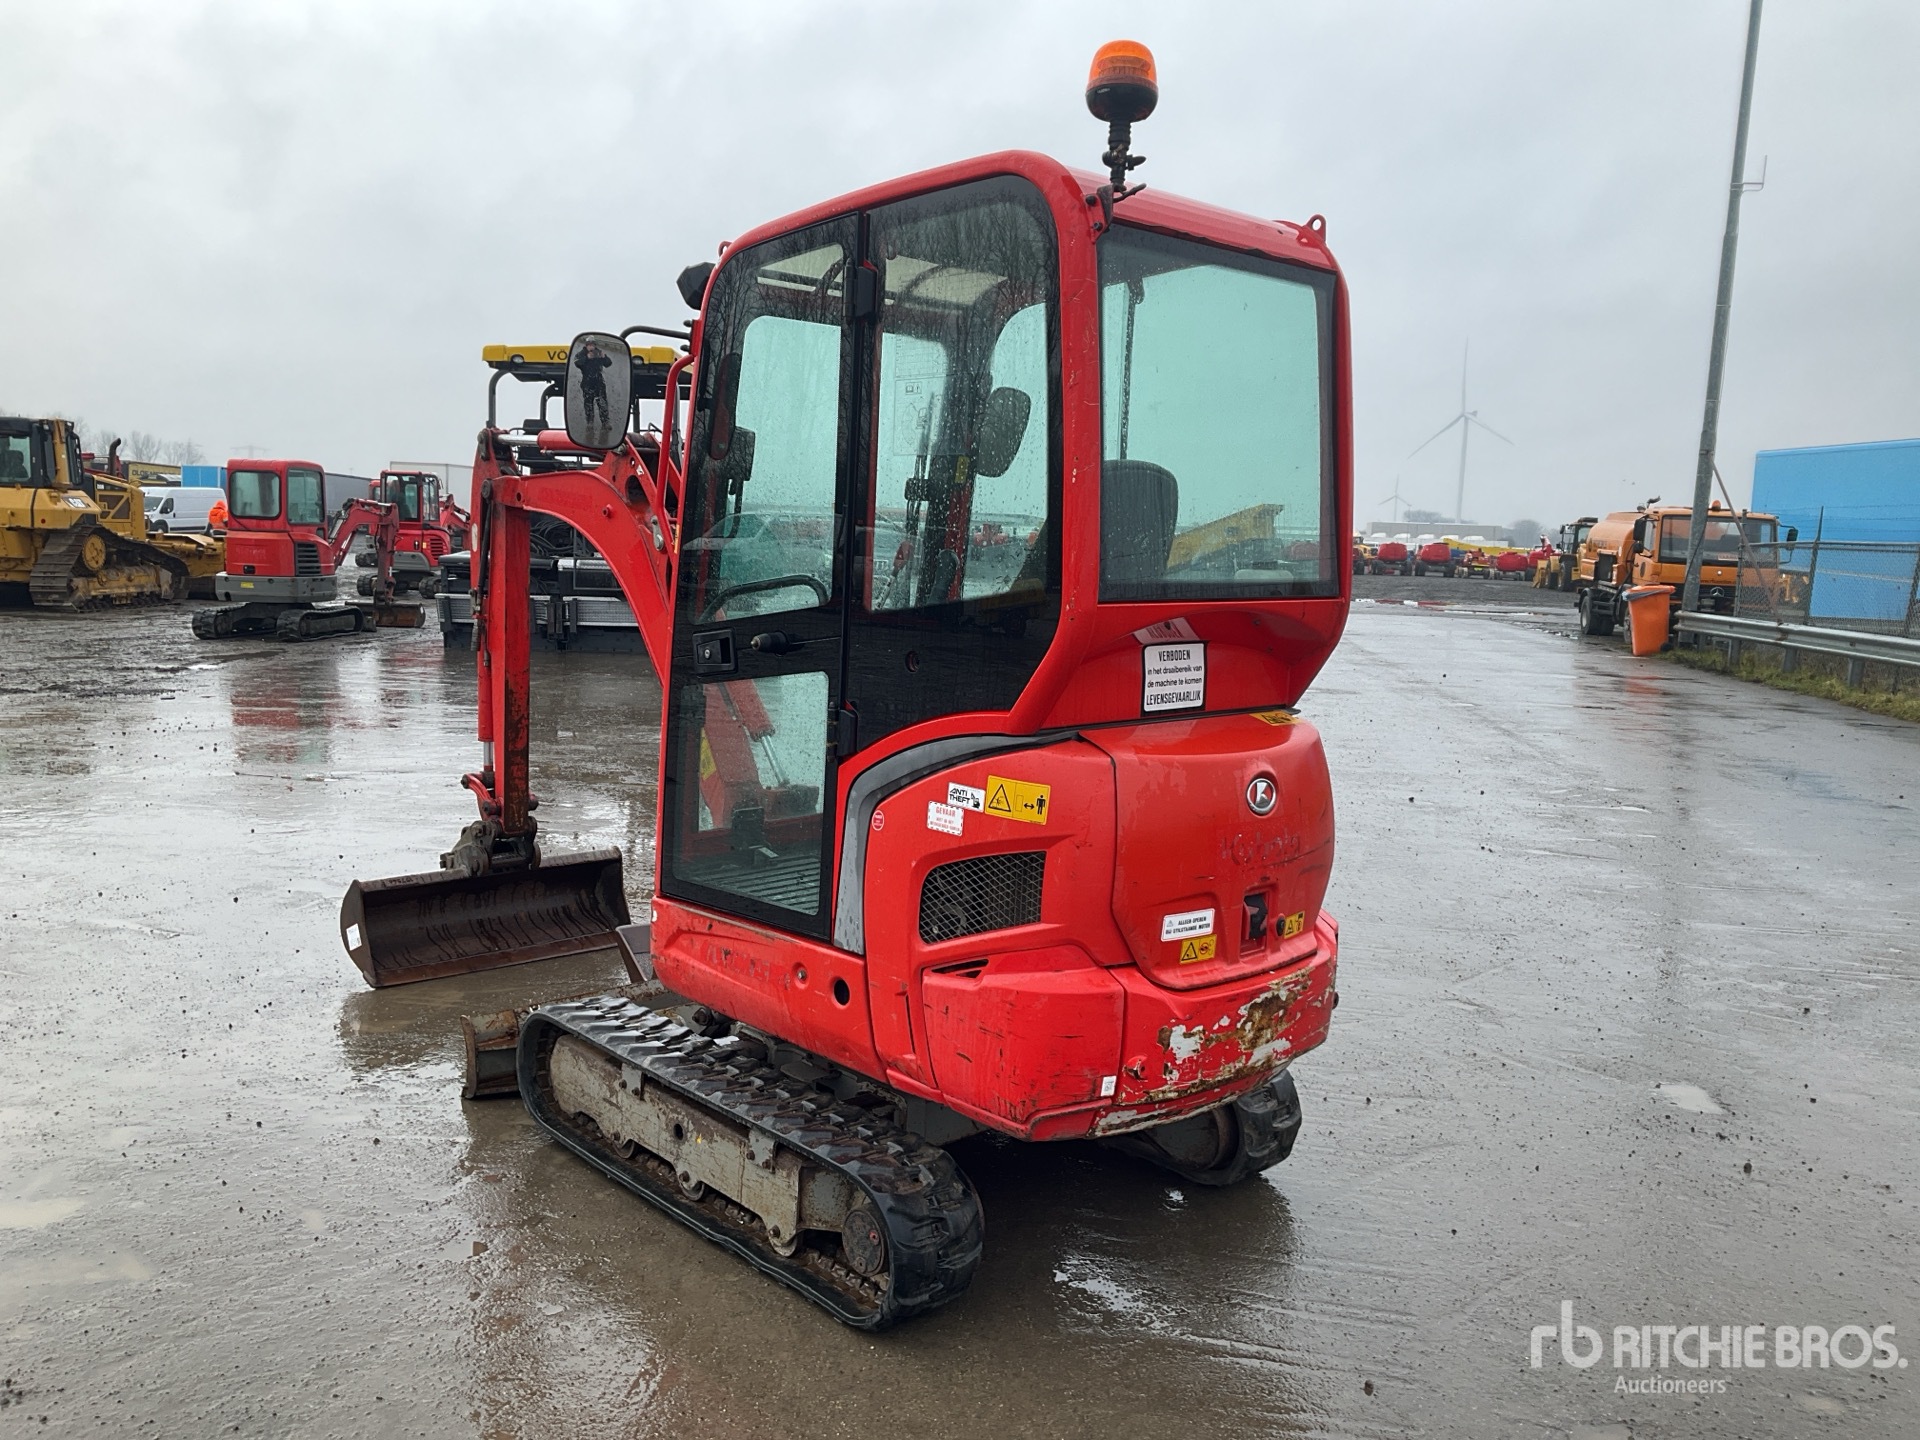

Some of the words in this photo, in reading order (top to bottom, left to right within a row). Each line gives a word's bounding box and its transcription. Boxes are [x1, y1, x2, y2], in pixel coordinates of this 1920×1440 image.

[1158, 649, 1191, 662] VERBODEN
[1163, 665, 1192, 674] draaibereik
[1147, 680, 1154, 688] de
[1155, 678, 1177, 687] machine
[1185, 677, 1202, 685] komen
[1146, 690, 1201, 705] LEVENSGEVAARLIJK
[949, 787, 968, 797] ANTI
[949, 793, 971, 804] THEFT
[935, 806, 956, 817] GEVAAR
